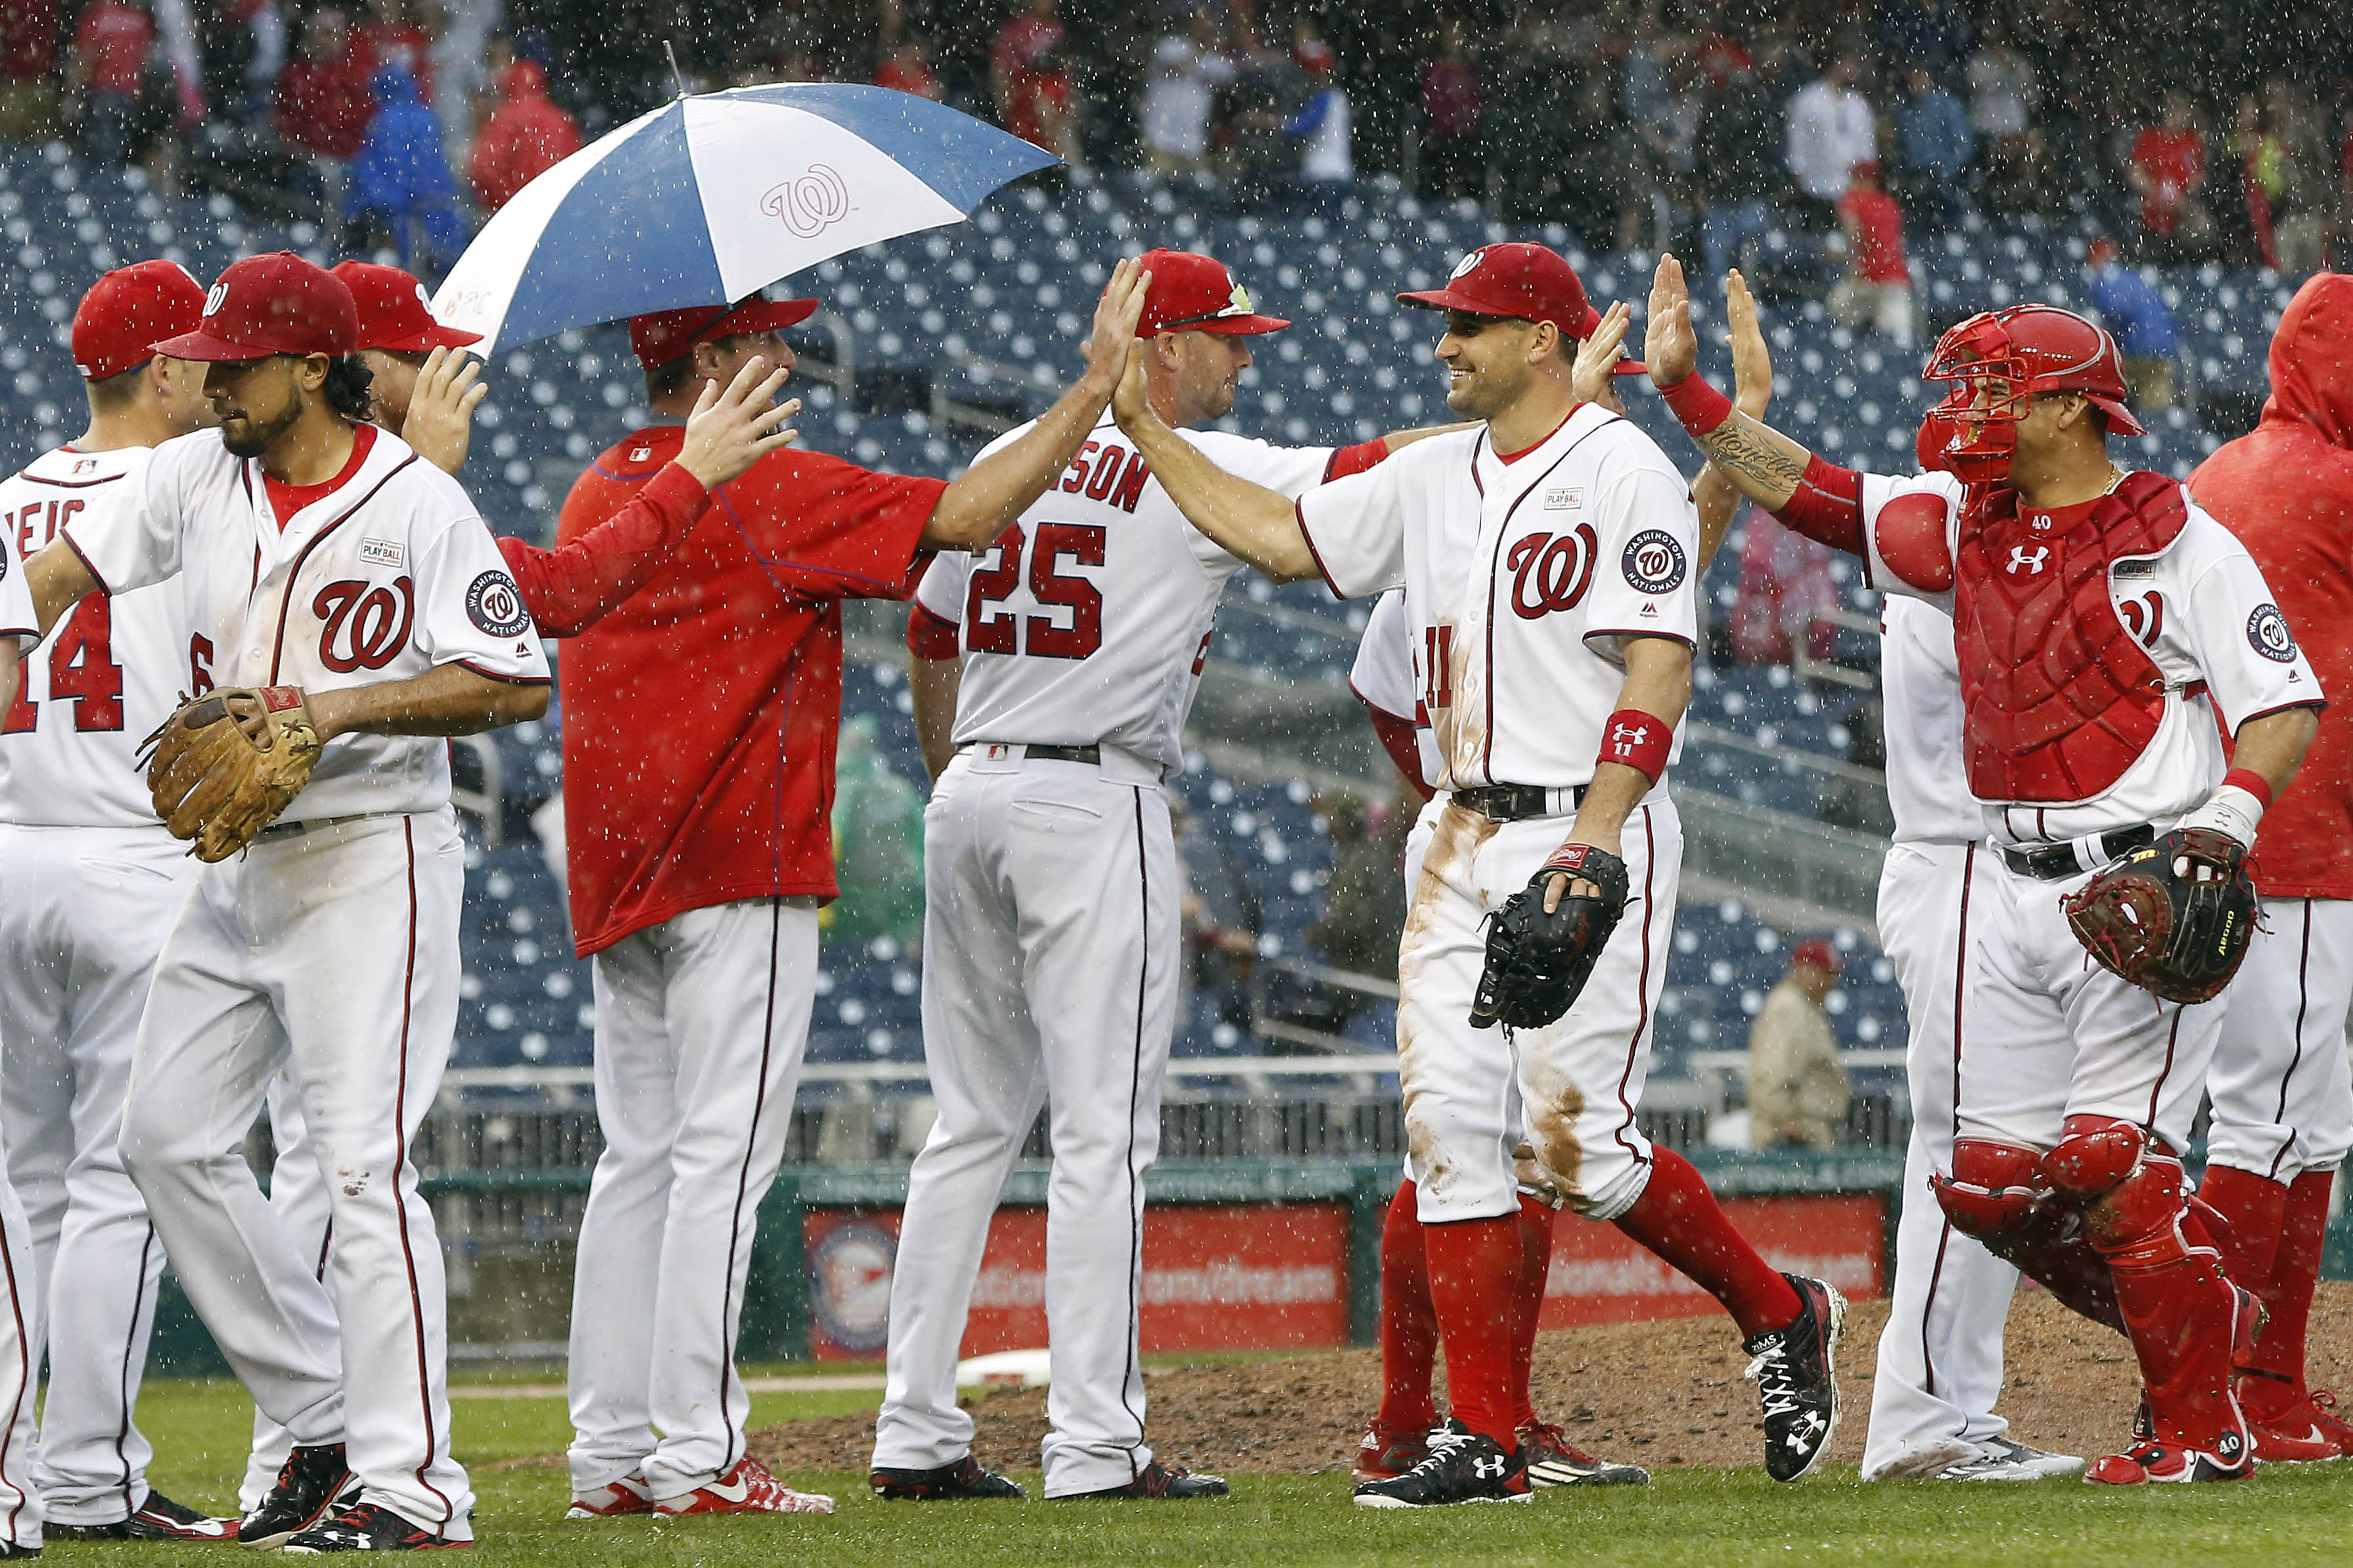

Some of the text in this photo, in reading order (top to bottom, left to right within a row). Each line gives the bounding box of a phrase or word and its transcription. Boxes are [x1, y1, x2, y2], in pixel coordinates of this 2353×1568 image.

[760, 164, 849, 239] W
[1049, 440, 1151, 514] SON
[1547, 493, 1580, 504] PLAY BALL
[2032, 514, 2051, 529] 40
[363, 545, 401, 560] PLAY BALL
[1626, 531, 1683, 560] WASHINGTON
[1507, 523, 1598, 619] W
[1627, 572, 1681, 592] NATIONALS
[468, 572, 520, 608] WASHINGTON
[966, 521, 1107, 660] 25
[313, 575, 414, 673] W
[482, 609, 529, 635] NATIONALS
[1426, 625, 1452, 709] 11
[1614, 742, 1632, 757] 11
[2219, 1435, 2240, 1454] 40
